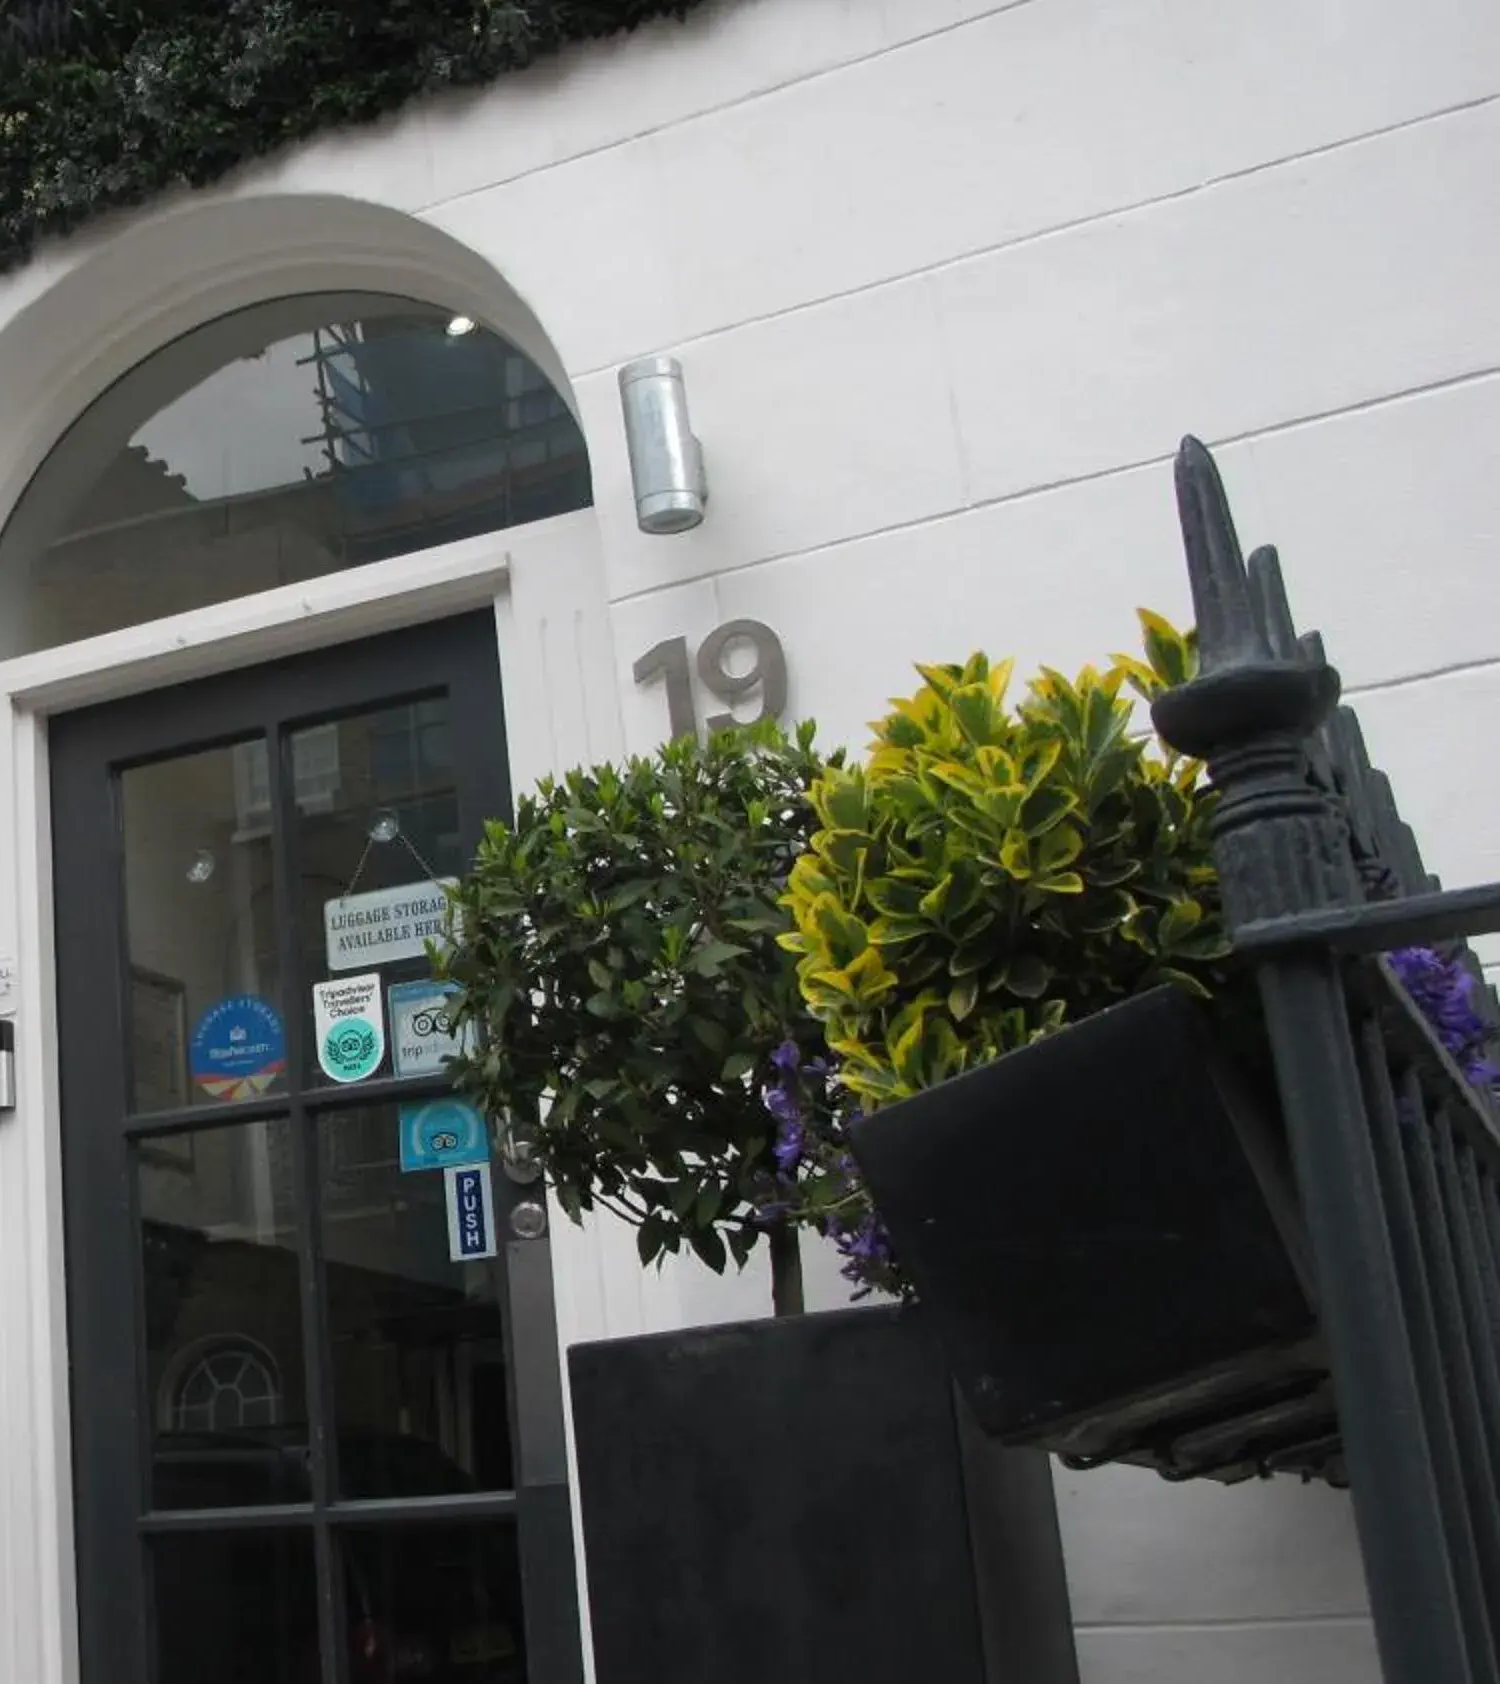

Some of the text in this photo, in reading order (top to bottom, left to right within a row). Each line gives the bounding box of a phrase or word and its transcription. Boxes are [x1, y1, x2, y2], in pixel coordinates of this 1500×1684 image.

[633, 618, 788, 744] 19
[331, 895, 447, 931] LUGGAGE STORAG
[338, 923, 411, 952] AVAILABLE
[463, 1177, 481, 1247] PUSH
